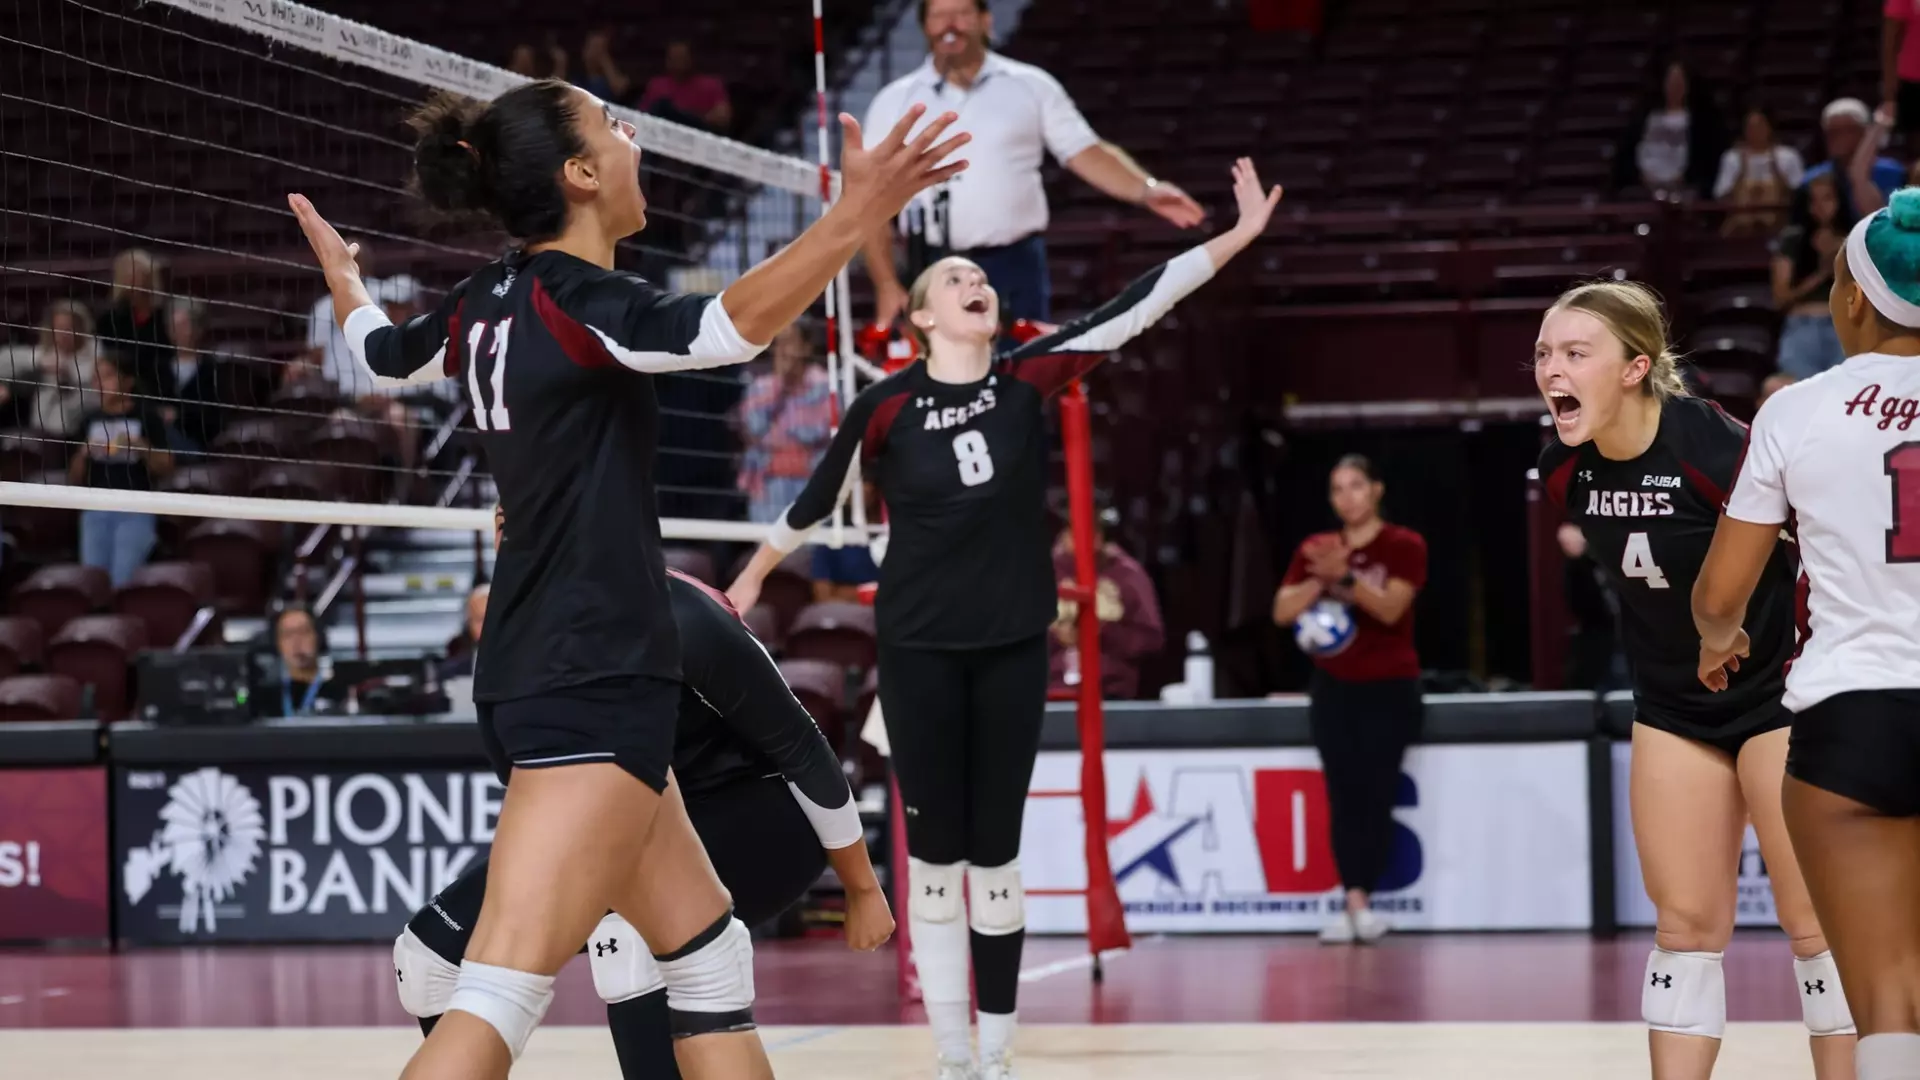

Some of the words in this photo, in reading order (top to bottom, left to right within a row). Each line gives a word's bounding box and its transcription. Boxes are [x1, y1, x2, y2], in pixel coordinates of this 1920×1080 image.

[1845, 384, 1920, 430] Agg
[952, 429, 994, 487] 8
[1585, 490, 1674, 517] AGGIES
[1621, 532, 1670, 588] 4
[269, 847, 476, 914] BANK
